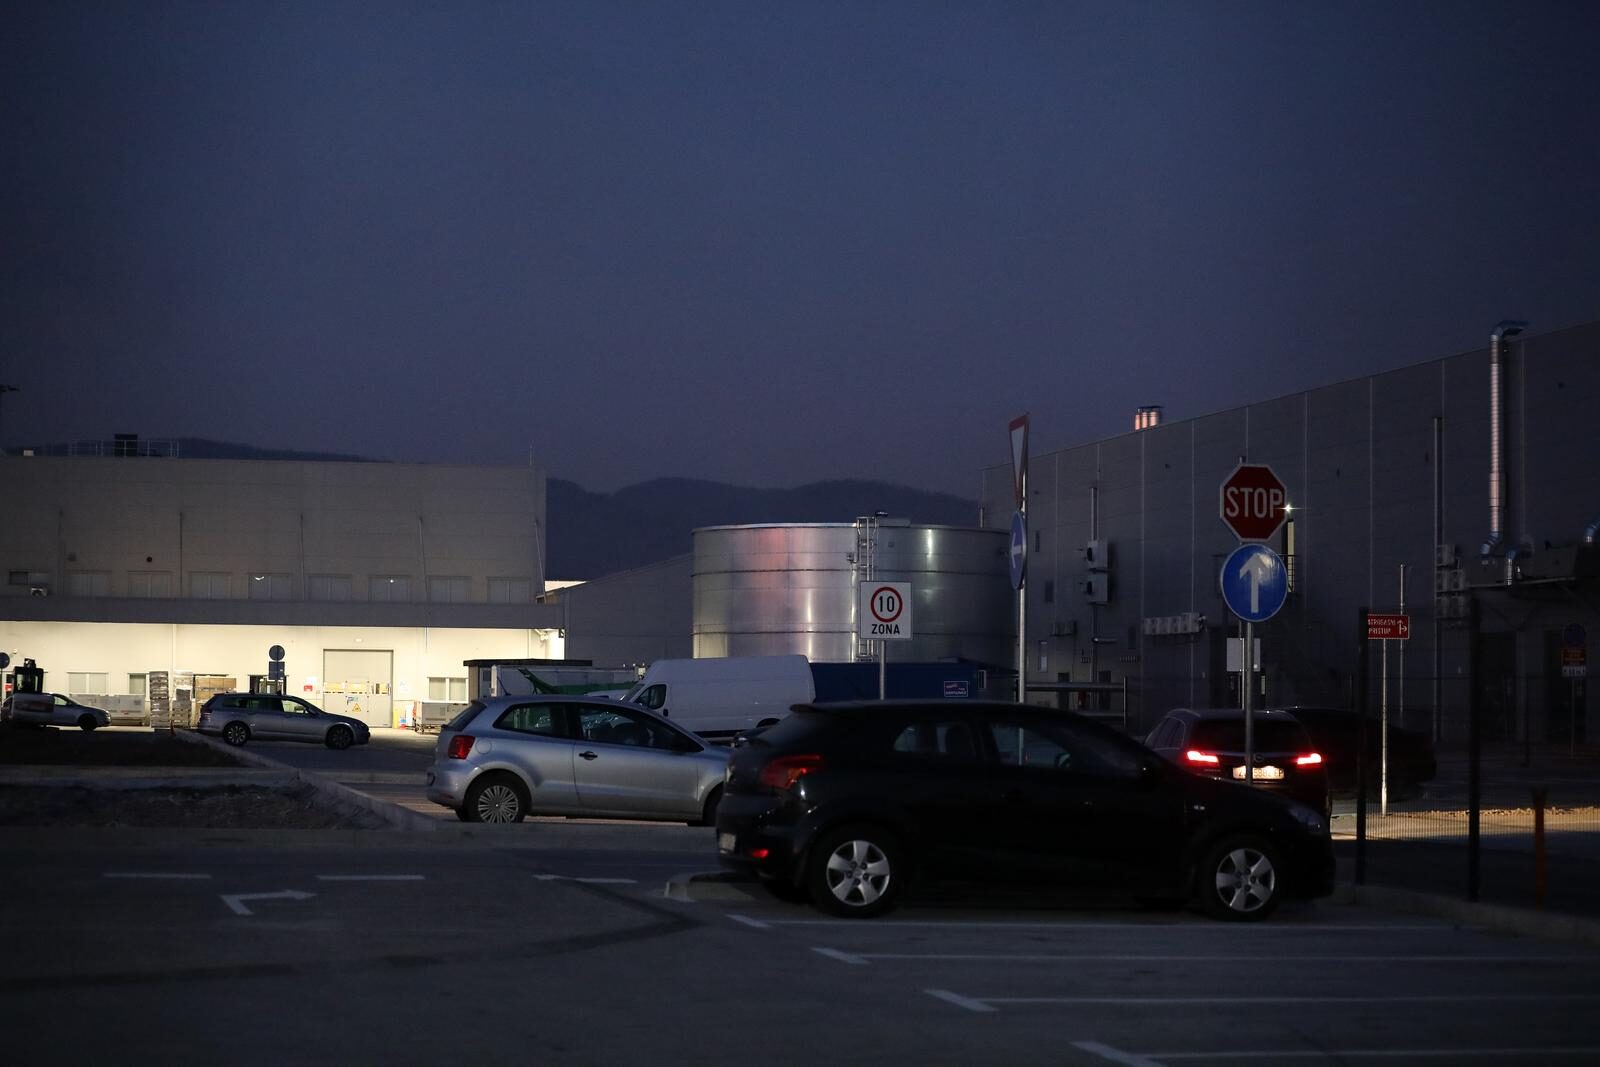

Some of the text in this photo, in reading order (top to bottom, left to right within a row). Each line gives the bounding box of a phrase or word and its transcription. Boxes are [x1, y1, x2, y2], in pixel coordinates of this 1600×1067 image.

[1225, 486, 1283, 519] STOP
[879, 595, 894, 612] 10
[871, 624, 900, 635] ZONA
